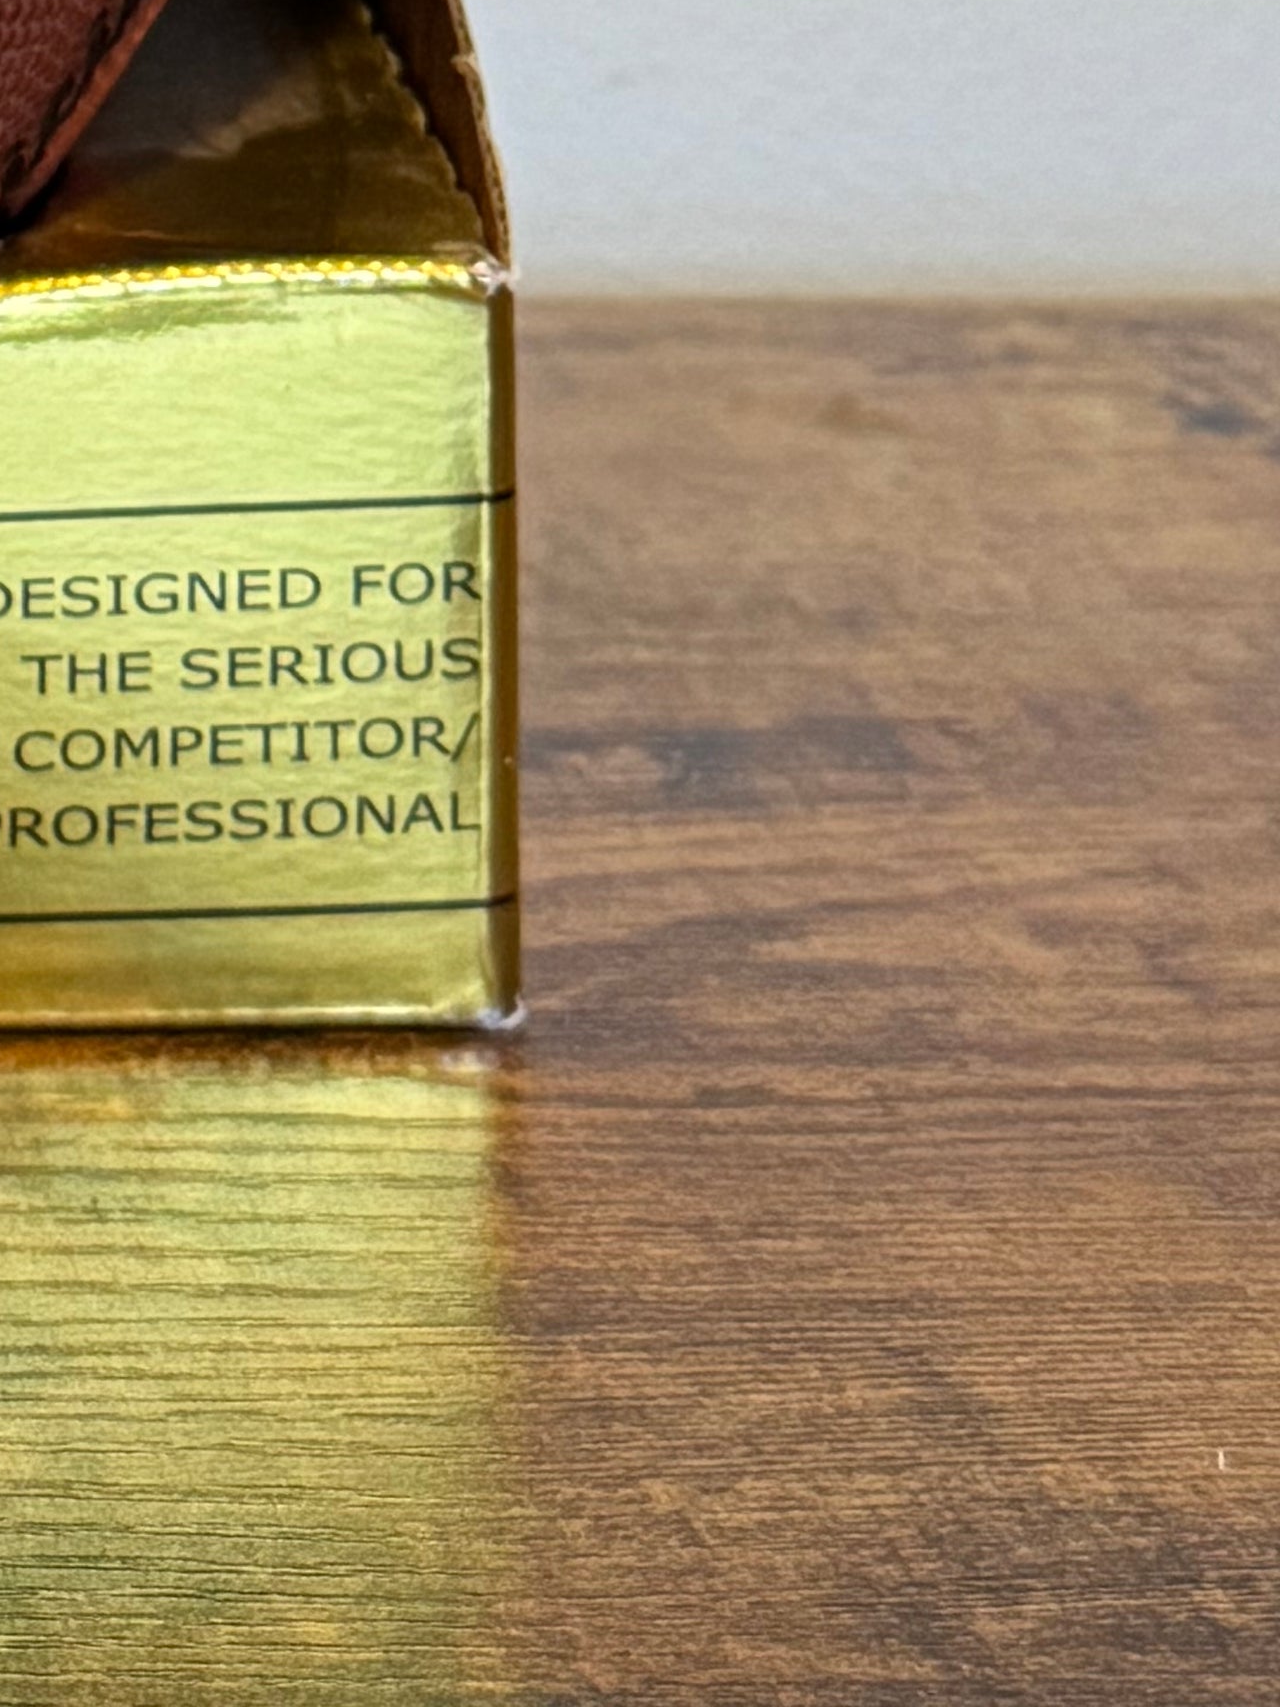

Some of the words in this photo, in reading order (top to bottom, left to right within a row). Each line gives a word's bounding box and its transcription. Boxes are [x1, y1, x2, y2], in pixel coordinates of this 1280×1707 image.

[352, 561, 481, 607] FOR
[20, 651, 153, 694] THE
[180, 637, 481, 689] SERIOUS
[13, 713, 481, 774] COMPETITOR/
